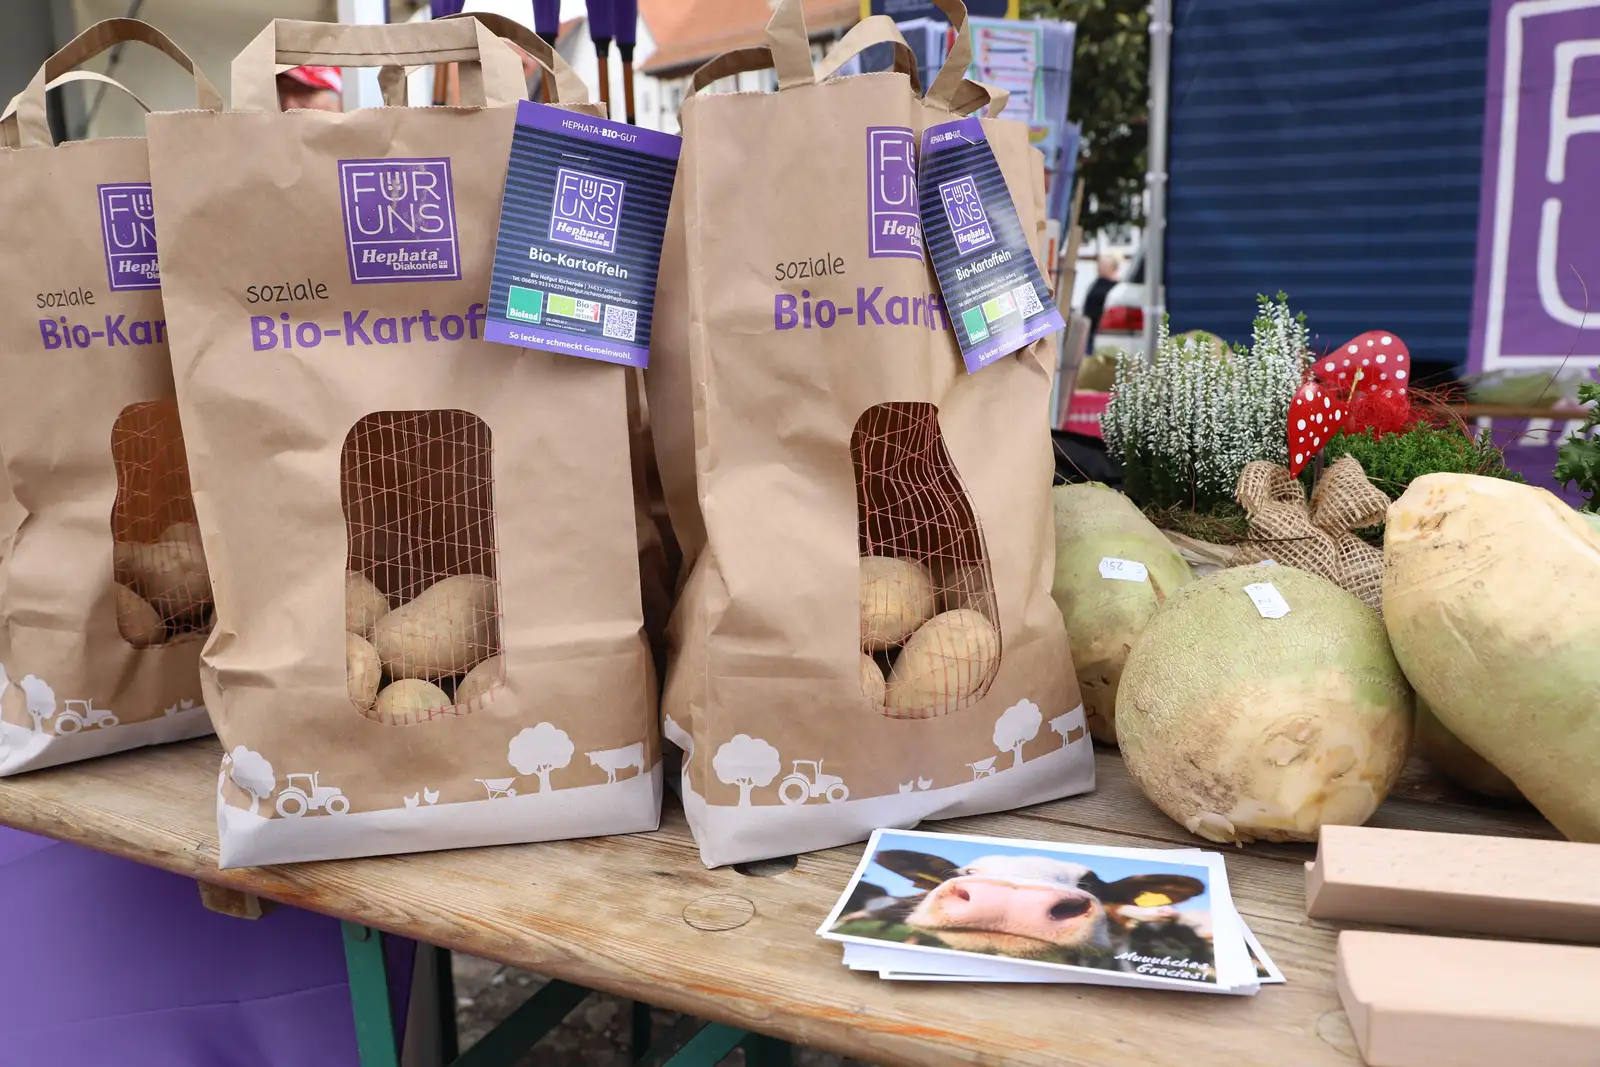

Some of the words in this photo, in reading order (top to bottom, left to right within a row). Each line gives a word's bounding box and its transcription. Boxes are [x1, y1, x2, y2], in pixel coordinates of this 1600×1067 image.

[562, 119, 637, 143] HEPHATA-BIO-GUT
[355, 203, 444, 235] UNS
[560, 195, 613, 225] UNS
[949, 201, 982, 227] UNS
[112, 222, 157, 248] UN
[556, 221, 607, 240] Hephata
[118, 260, 159, 274] Heph
[362, 248, 439, 265] Hephata
[393, 261, 438, 271] Diakonie
[529, 247, 628, 279] Bio-Kartoffeln
[774, 252, 846, 281] soziale
[955, 249, 1012, 281] Bio-Kartoffeln
[37, 287, 95, 308] soziale
[246, 279, 329, 303] soziale
[509, 308, 539, 321] Bioland
[576, 300, 590, 309] Bio
[39, 315, 167, 350] Bio-Kar
[250, 303, 487, 351] Bio-Kartof
[509, 331, 519, 340] So
[520, 333, 545, 344] lecker
[545, 338, 583, 351] schmeckt
[583, 344, 632, 360] Gemeinwohl.
[1136, 963, 1208, 981] Gracias!
